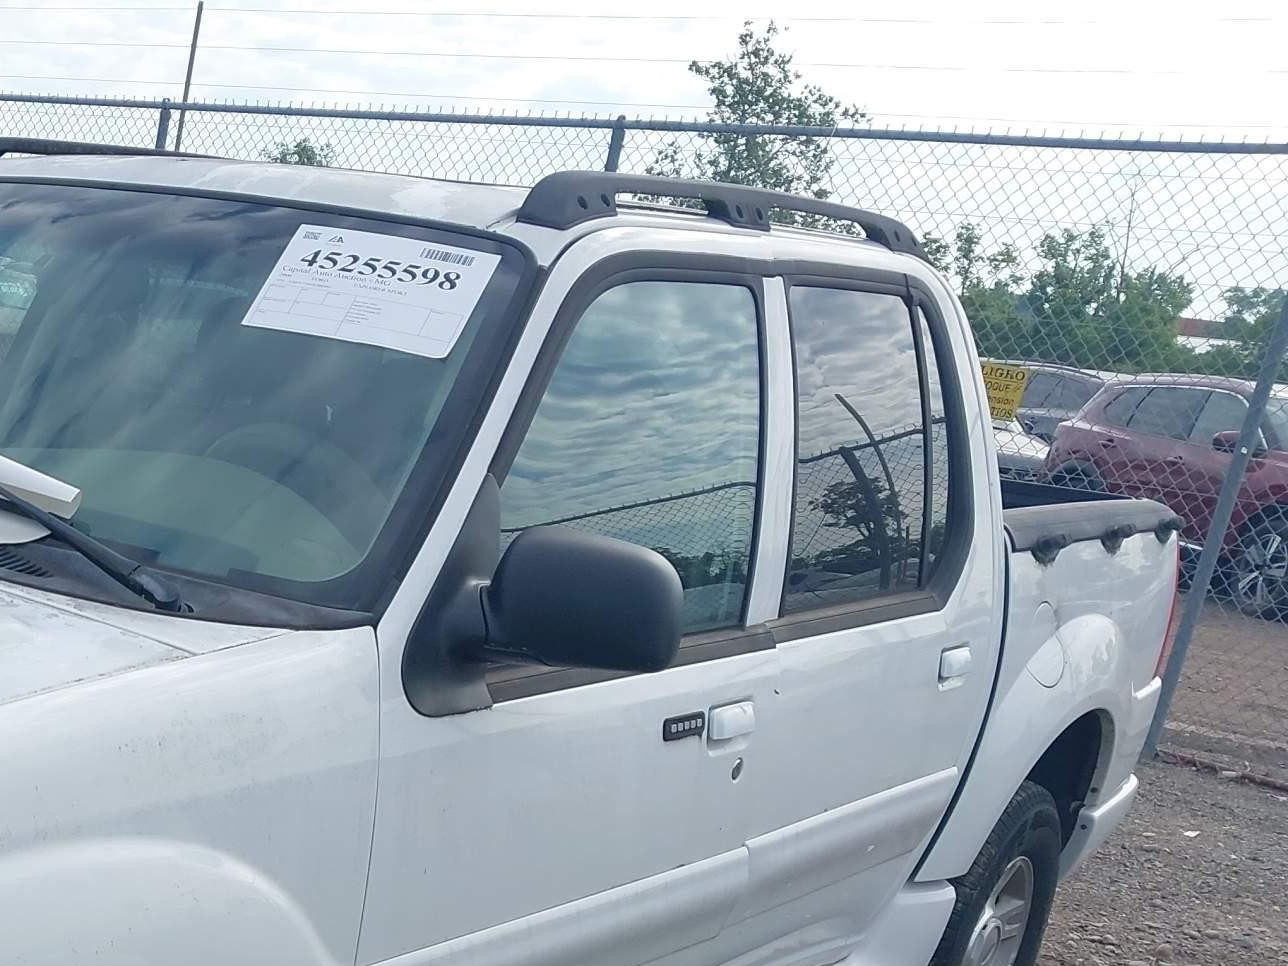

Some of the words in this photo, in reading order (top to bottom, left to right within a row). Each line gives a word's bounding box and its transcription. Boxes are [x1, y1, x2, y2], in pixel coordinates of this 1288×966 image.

[282, 265, 312, 274] Capital
[312, 270, 333, 278] Auto
[334, 272, 367, 282] Auction
[300, 249, 461, 291] 45255598
[984, 380, 1011, 392] OQUE
